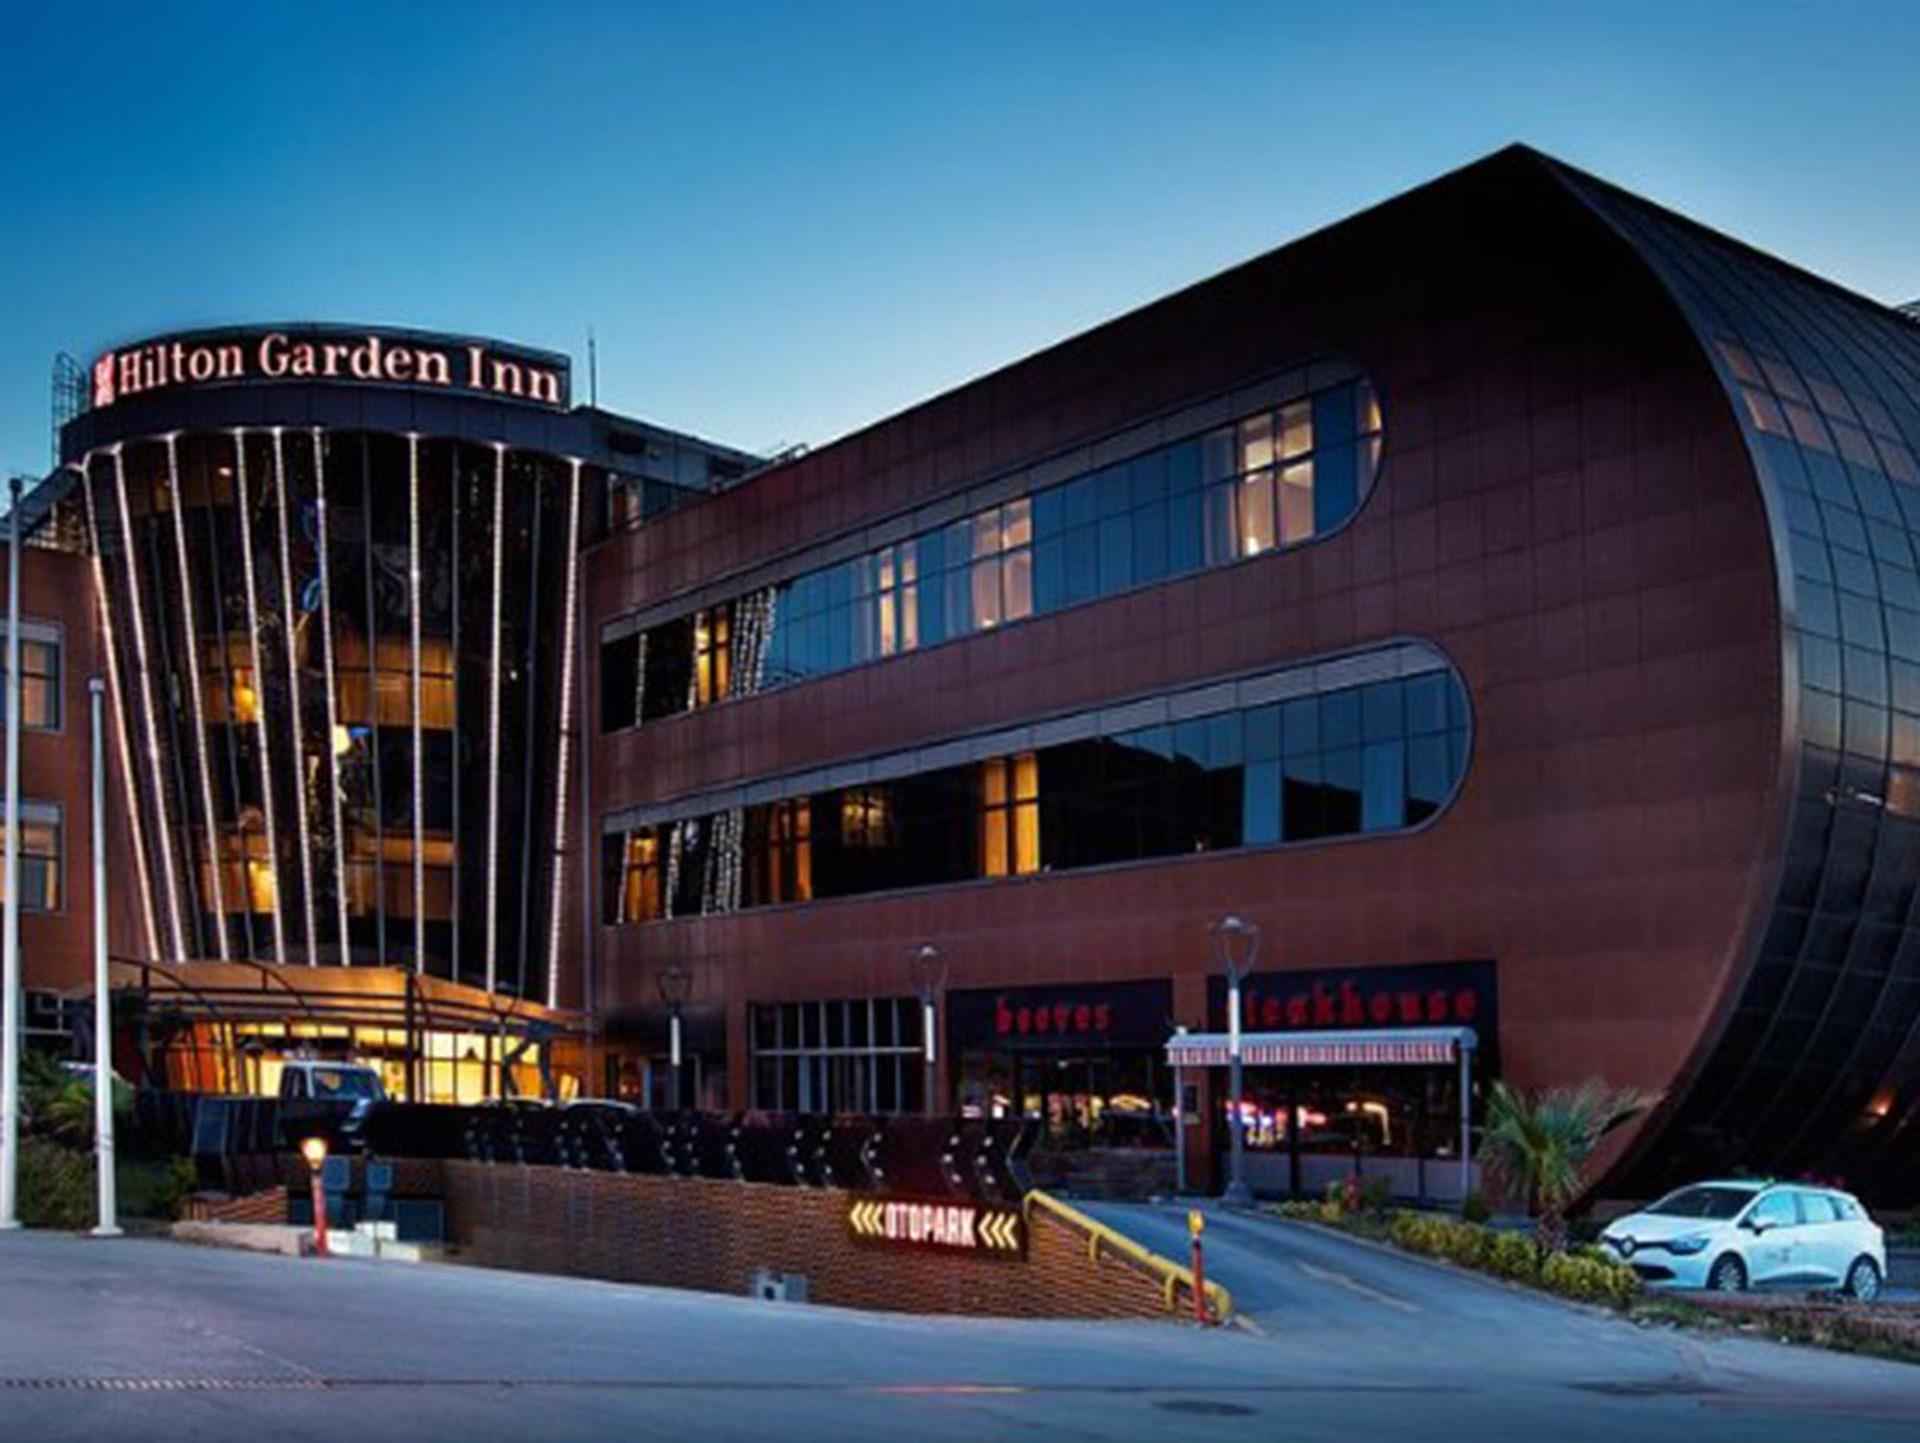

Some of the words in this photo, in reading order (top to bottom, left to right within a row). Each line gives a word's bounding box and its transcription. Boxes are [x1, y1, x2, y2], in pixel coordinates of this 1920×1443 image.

[119, 342, 243, 395] Hilton
[259, 333, 450, 384] Garden
[467, 346, 561, 403] Inn
[1227, 980, 1477, 1027] teakhouse
[885, 1202, 977, 1247] OTOPARK
